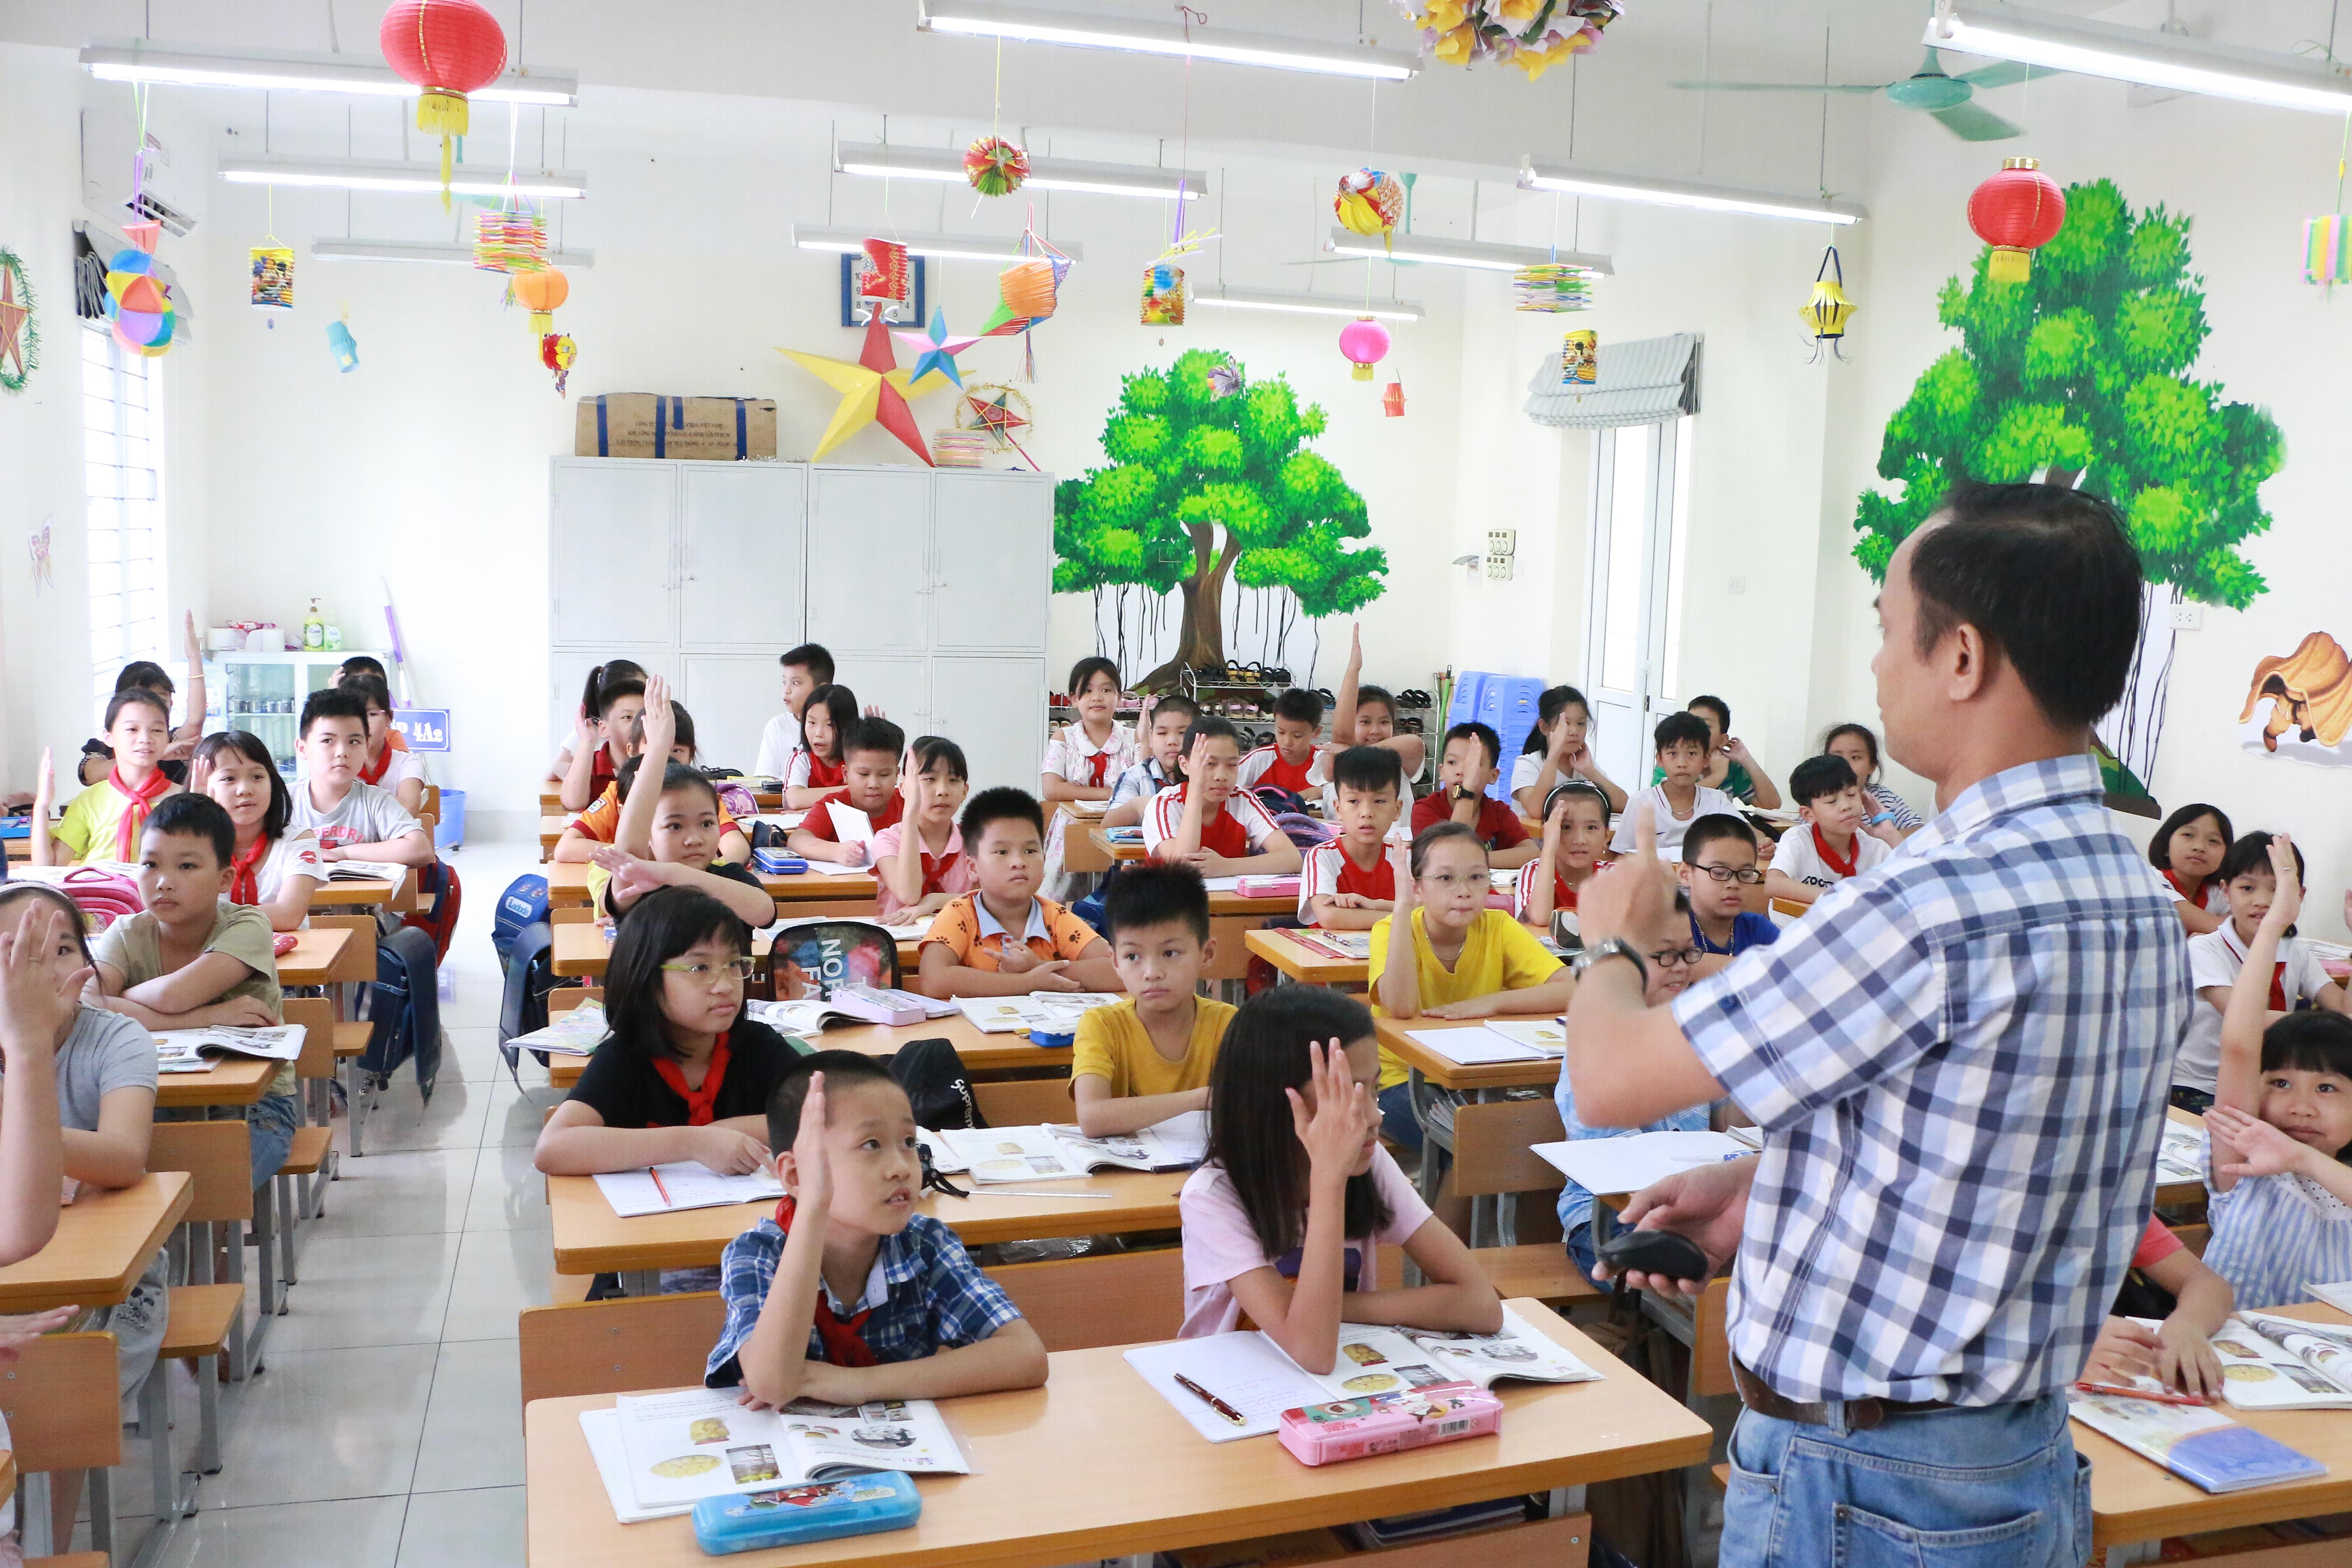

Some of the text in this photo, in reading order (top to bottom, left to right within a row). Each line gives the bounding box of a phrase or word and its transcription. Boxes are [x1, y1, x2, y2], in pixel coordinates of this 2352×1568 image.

[413, 721, 444, 743] 4A2
[801, 966, 823, 1000] FA
[821, 938, 844, 997] NOR
[950, 1078, 977, 1130] Suprem
